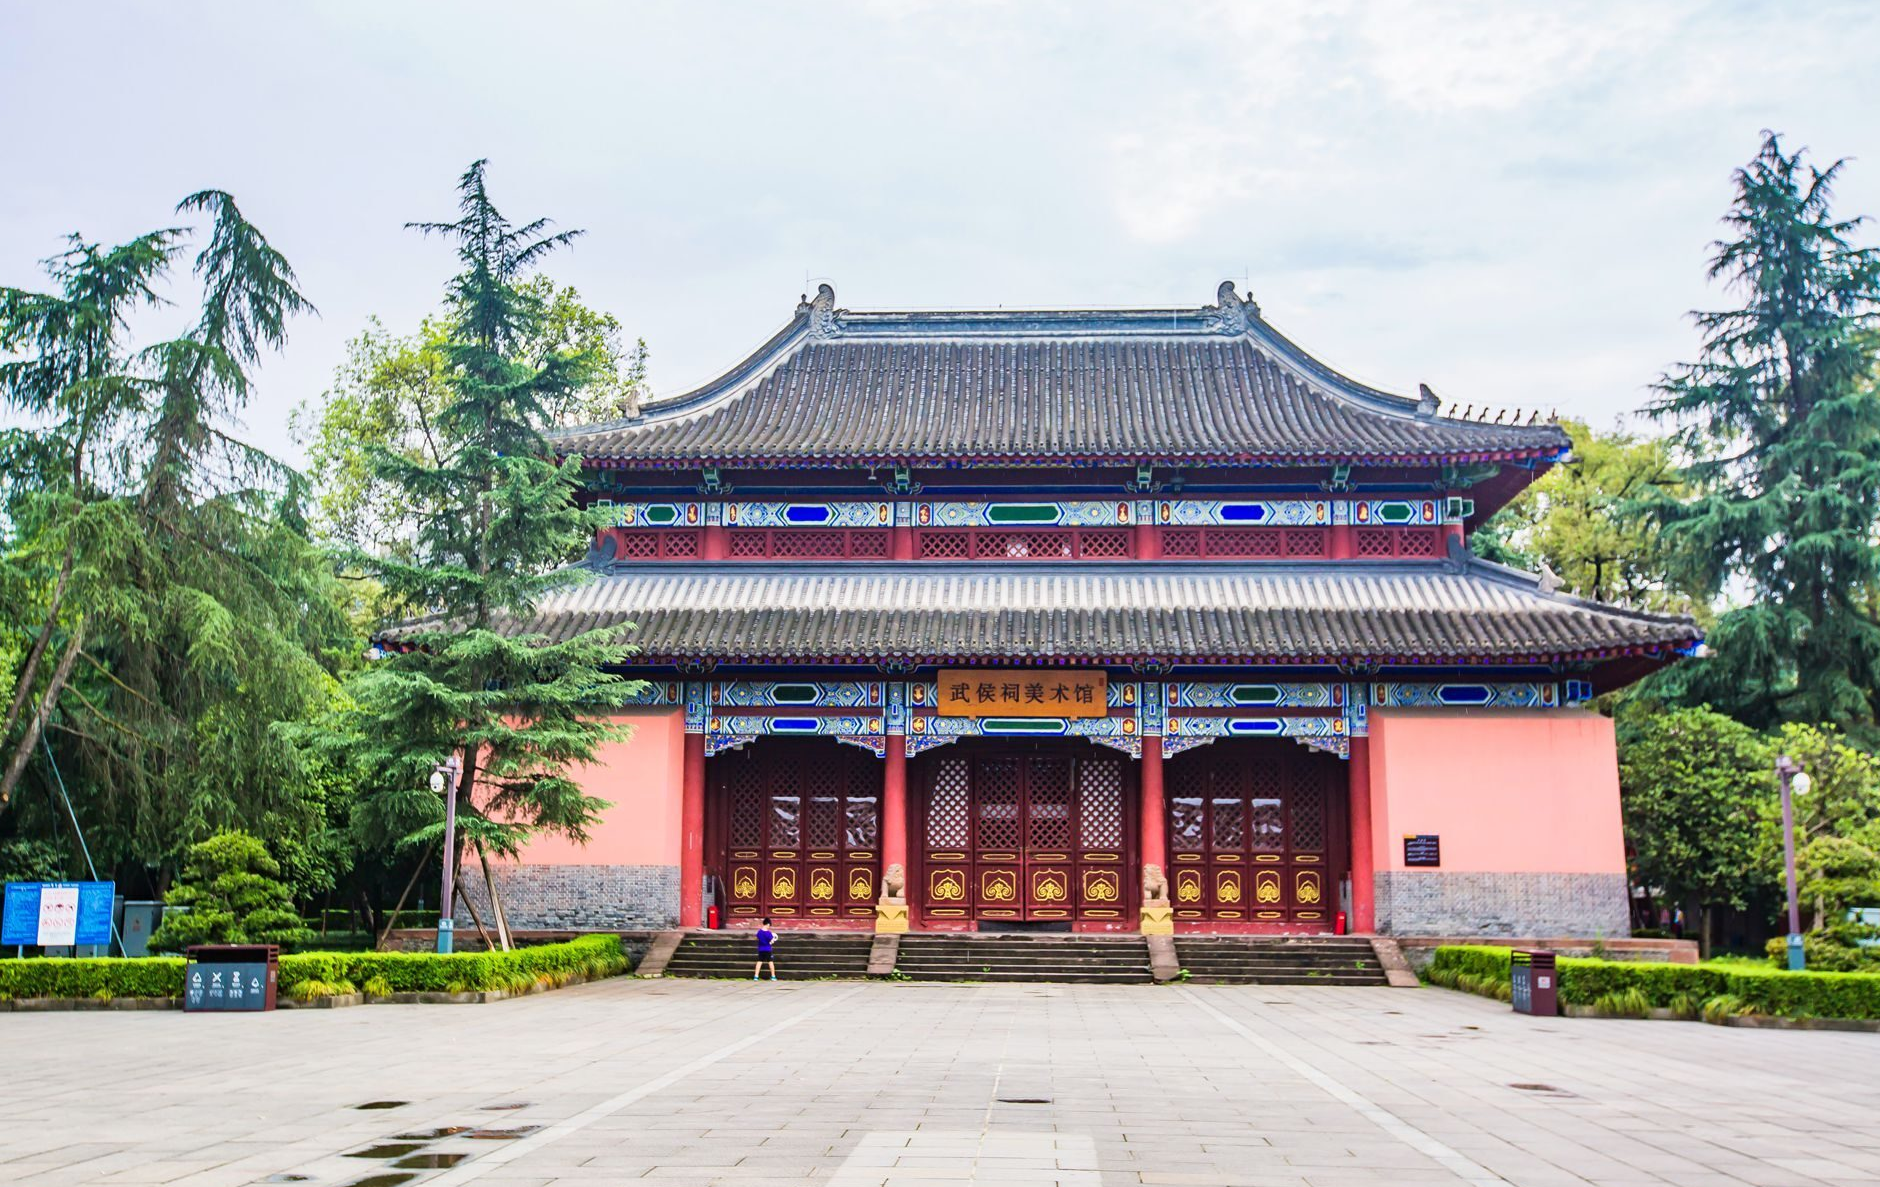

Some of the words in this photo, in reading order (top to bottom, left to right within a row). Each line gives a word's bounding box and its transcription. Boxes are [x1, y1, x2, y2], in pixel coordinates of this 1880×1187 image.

[950, 682, 1094, 704] 武侯祠美术馆
